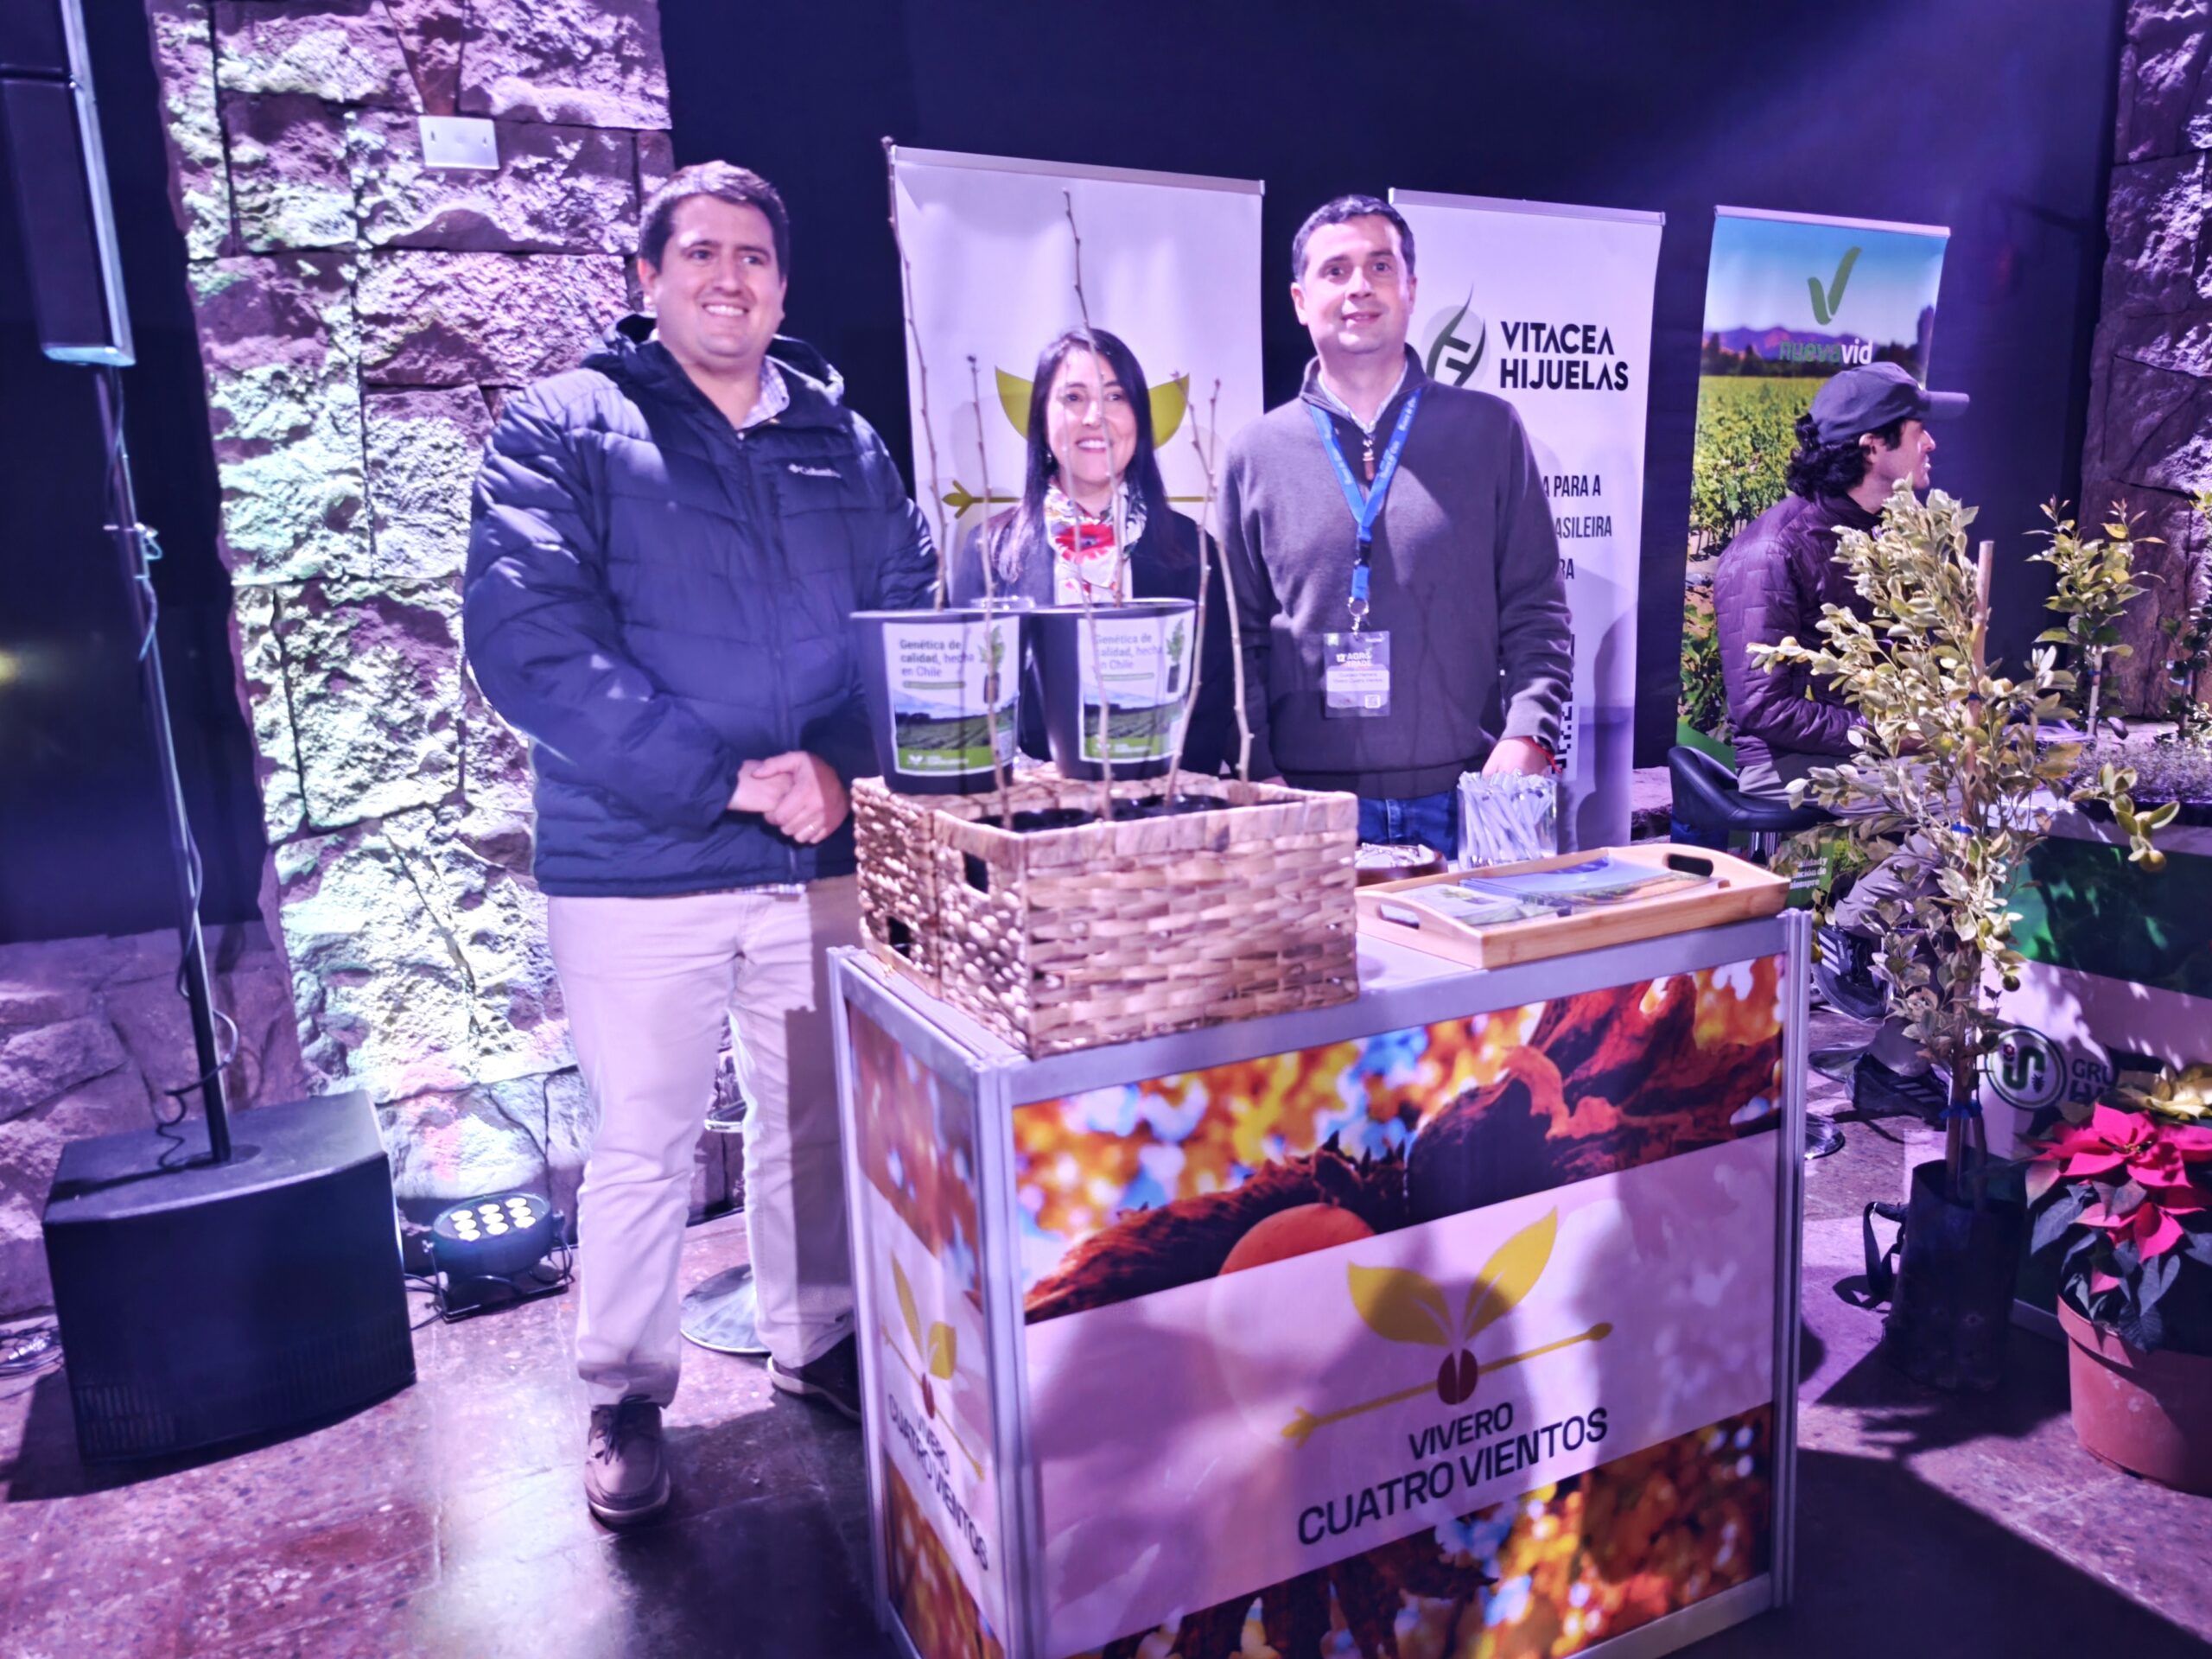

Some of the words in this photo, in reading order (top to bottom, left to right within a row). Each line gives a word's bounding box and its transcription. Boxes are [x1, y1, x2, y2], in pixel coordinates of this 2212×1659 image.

[1500, 321, 1615, 355] VITACEA
[1500, 359, 1629, 391] HIJUELAS
[1554, 475, 1588, 498] PARA
[1592, 474, 1601, 497] A
[949, 639, 962, 650] de
[916, 665, 942, 677] Chile
[1408, 1402, 1514, 1460] VIVERO
[1298, 1461, 1454, 1545] CUATRO
[1459, 1407, 1608, 1488] VIENTOS
